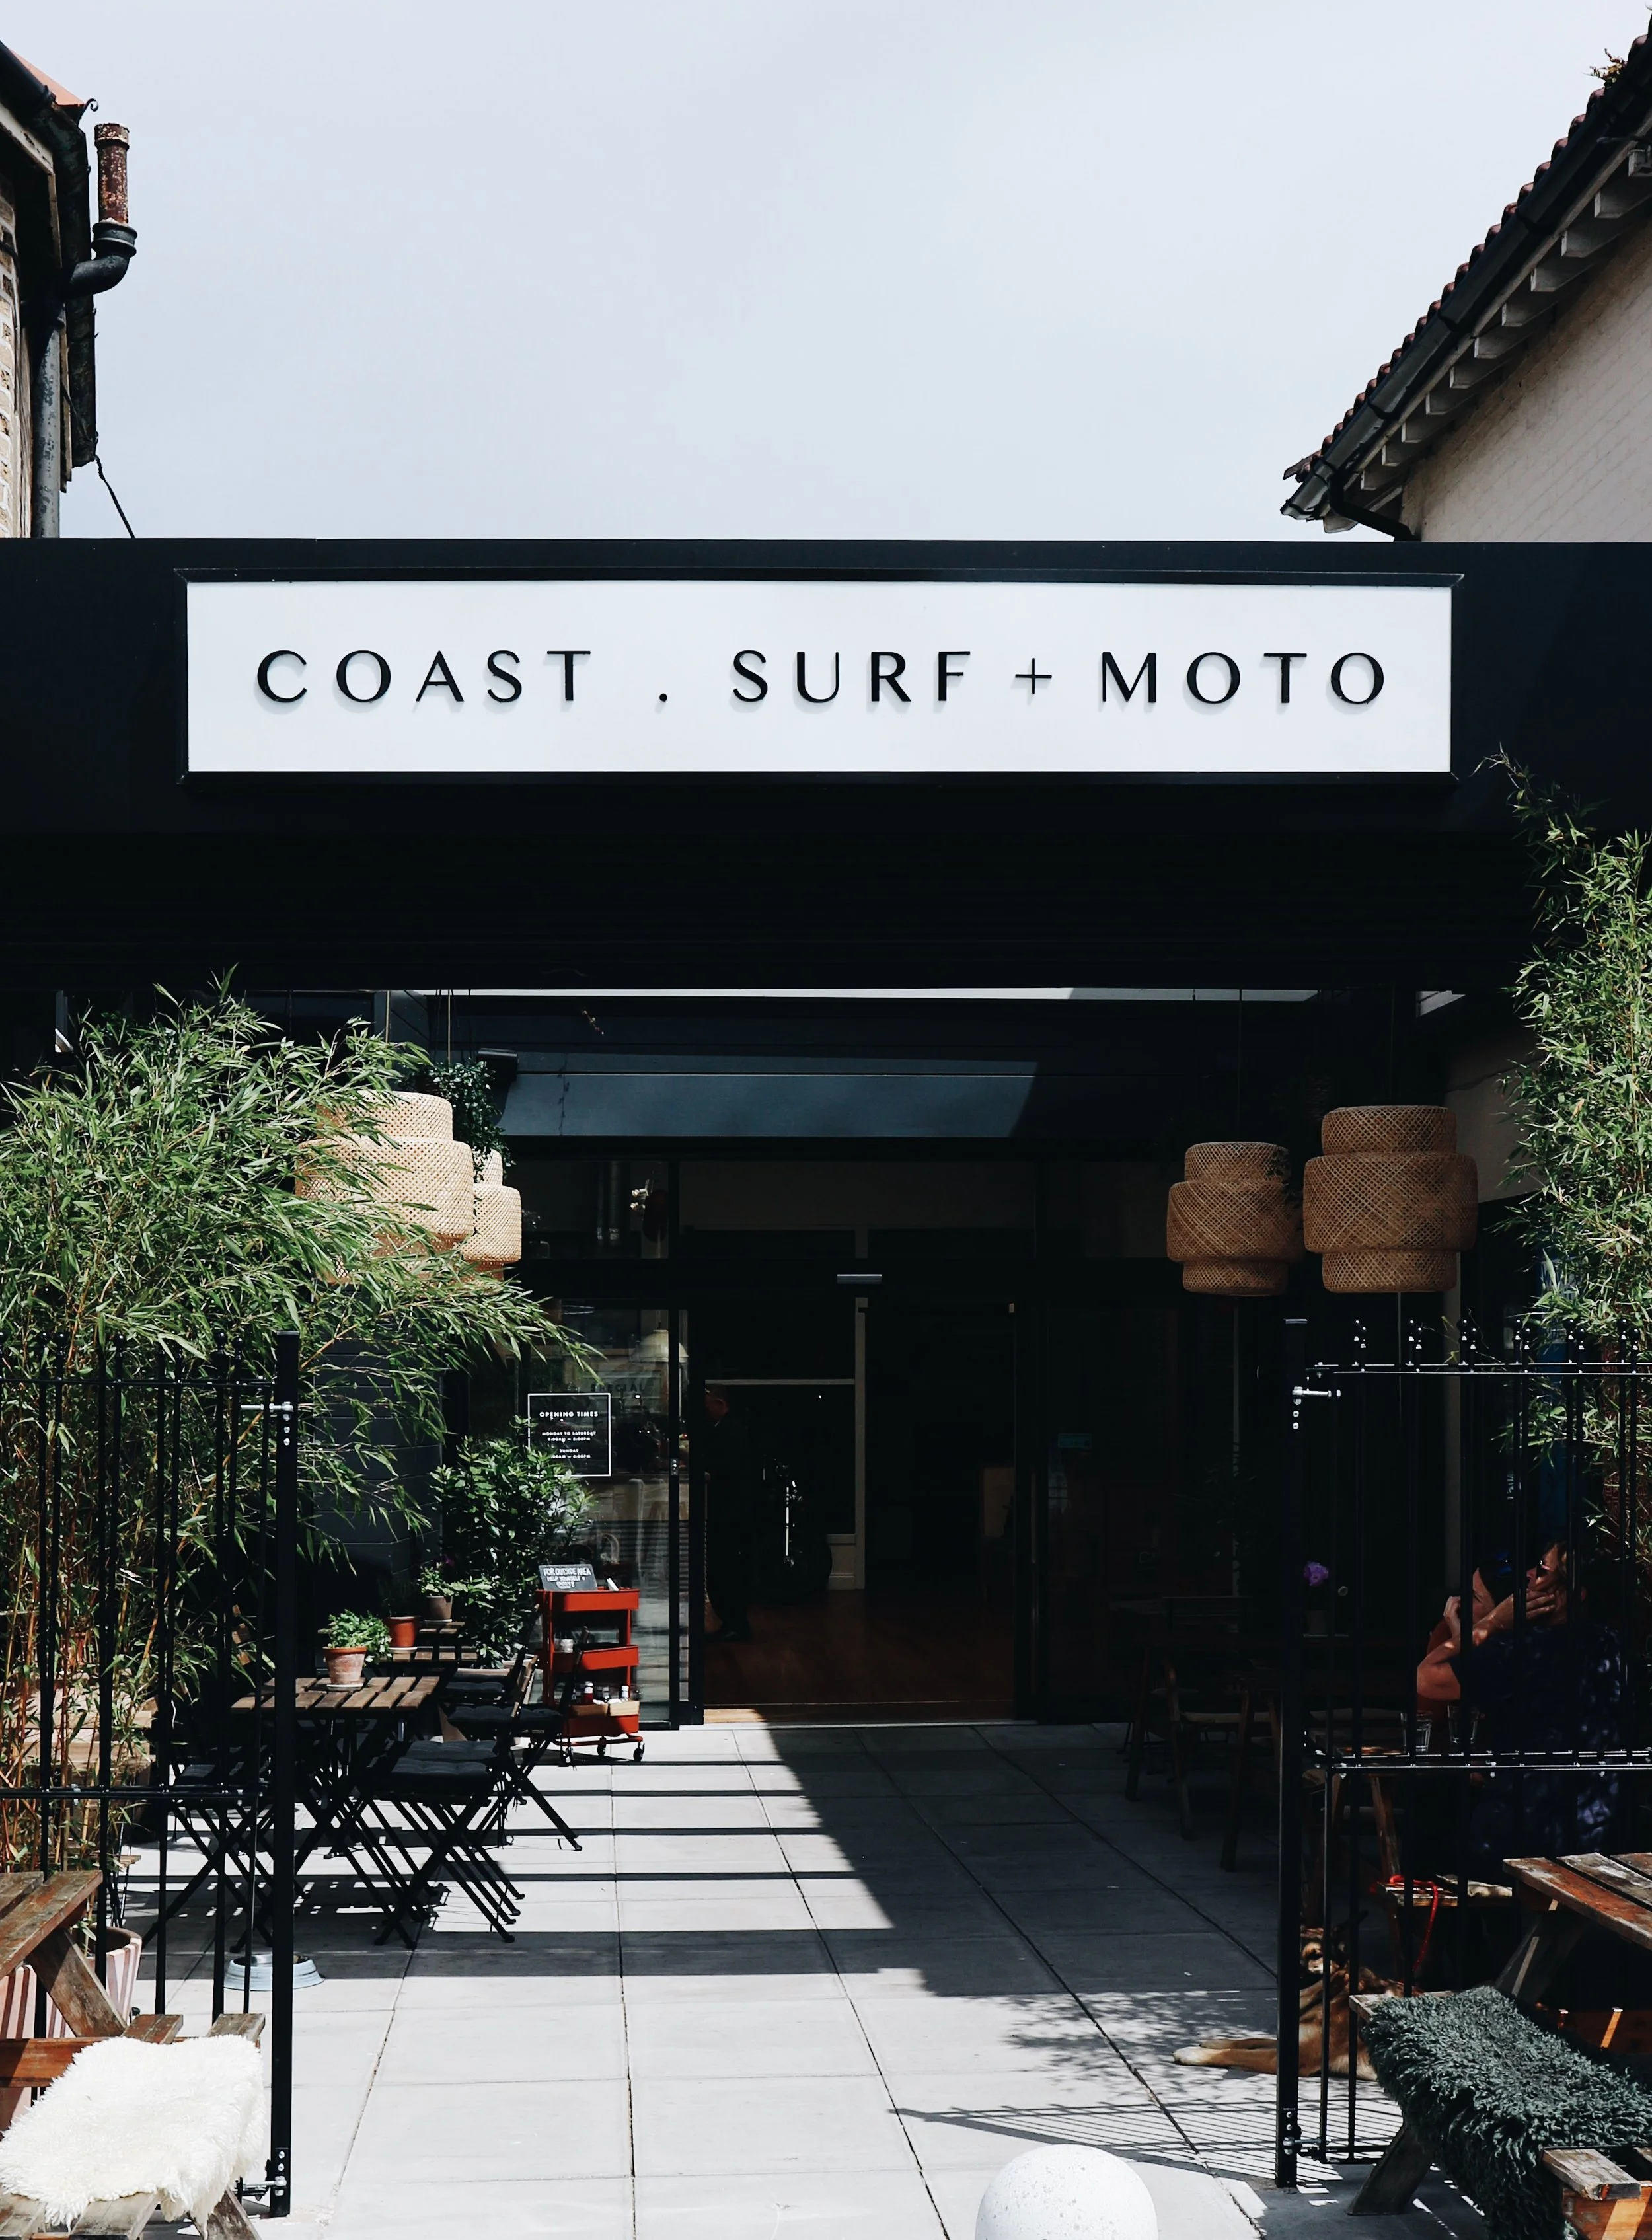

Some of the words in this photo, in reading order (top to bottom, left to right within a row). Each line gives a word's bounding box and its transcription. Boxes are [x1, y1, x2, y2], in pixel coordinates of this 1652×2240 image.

[257, 650, 591, 704] COAST
[733, 650, 971, 704] SURF
[1014, 657, 1053, 695] +
[1102, 652, 1384, 705] MOTO
